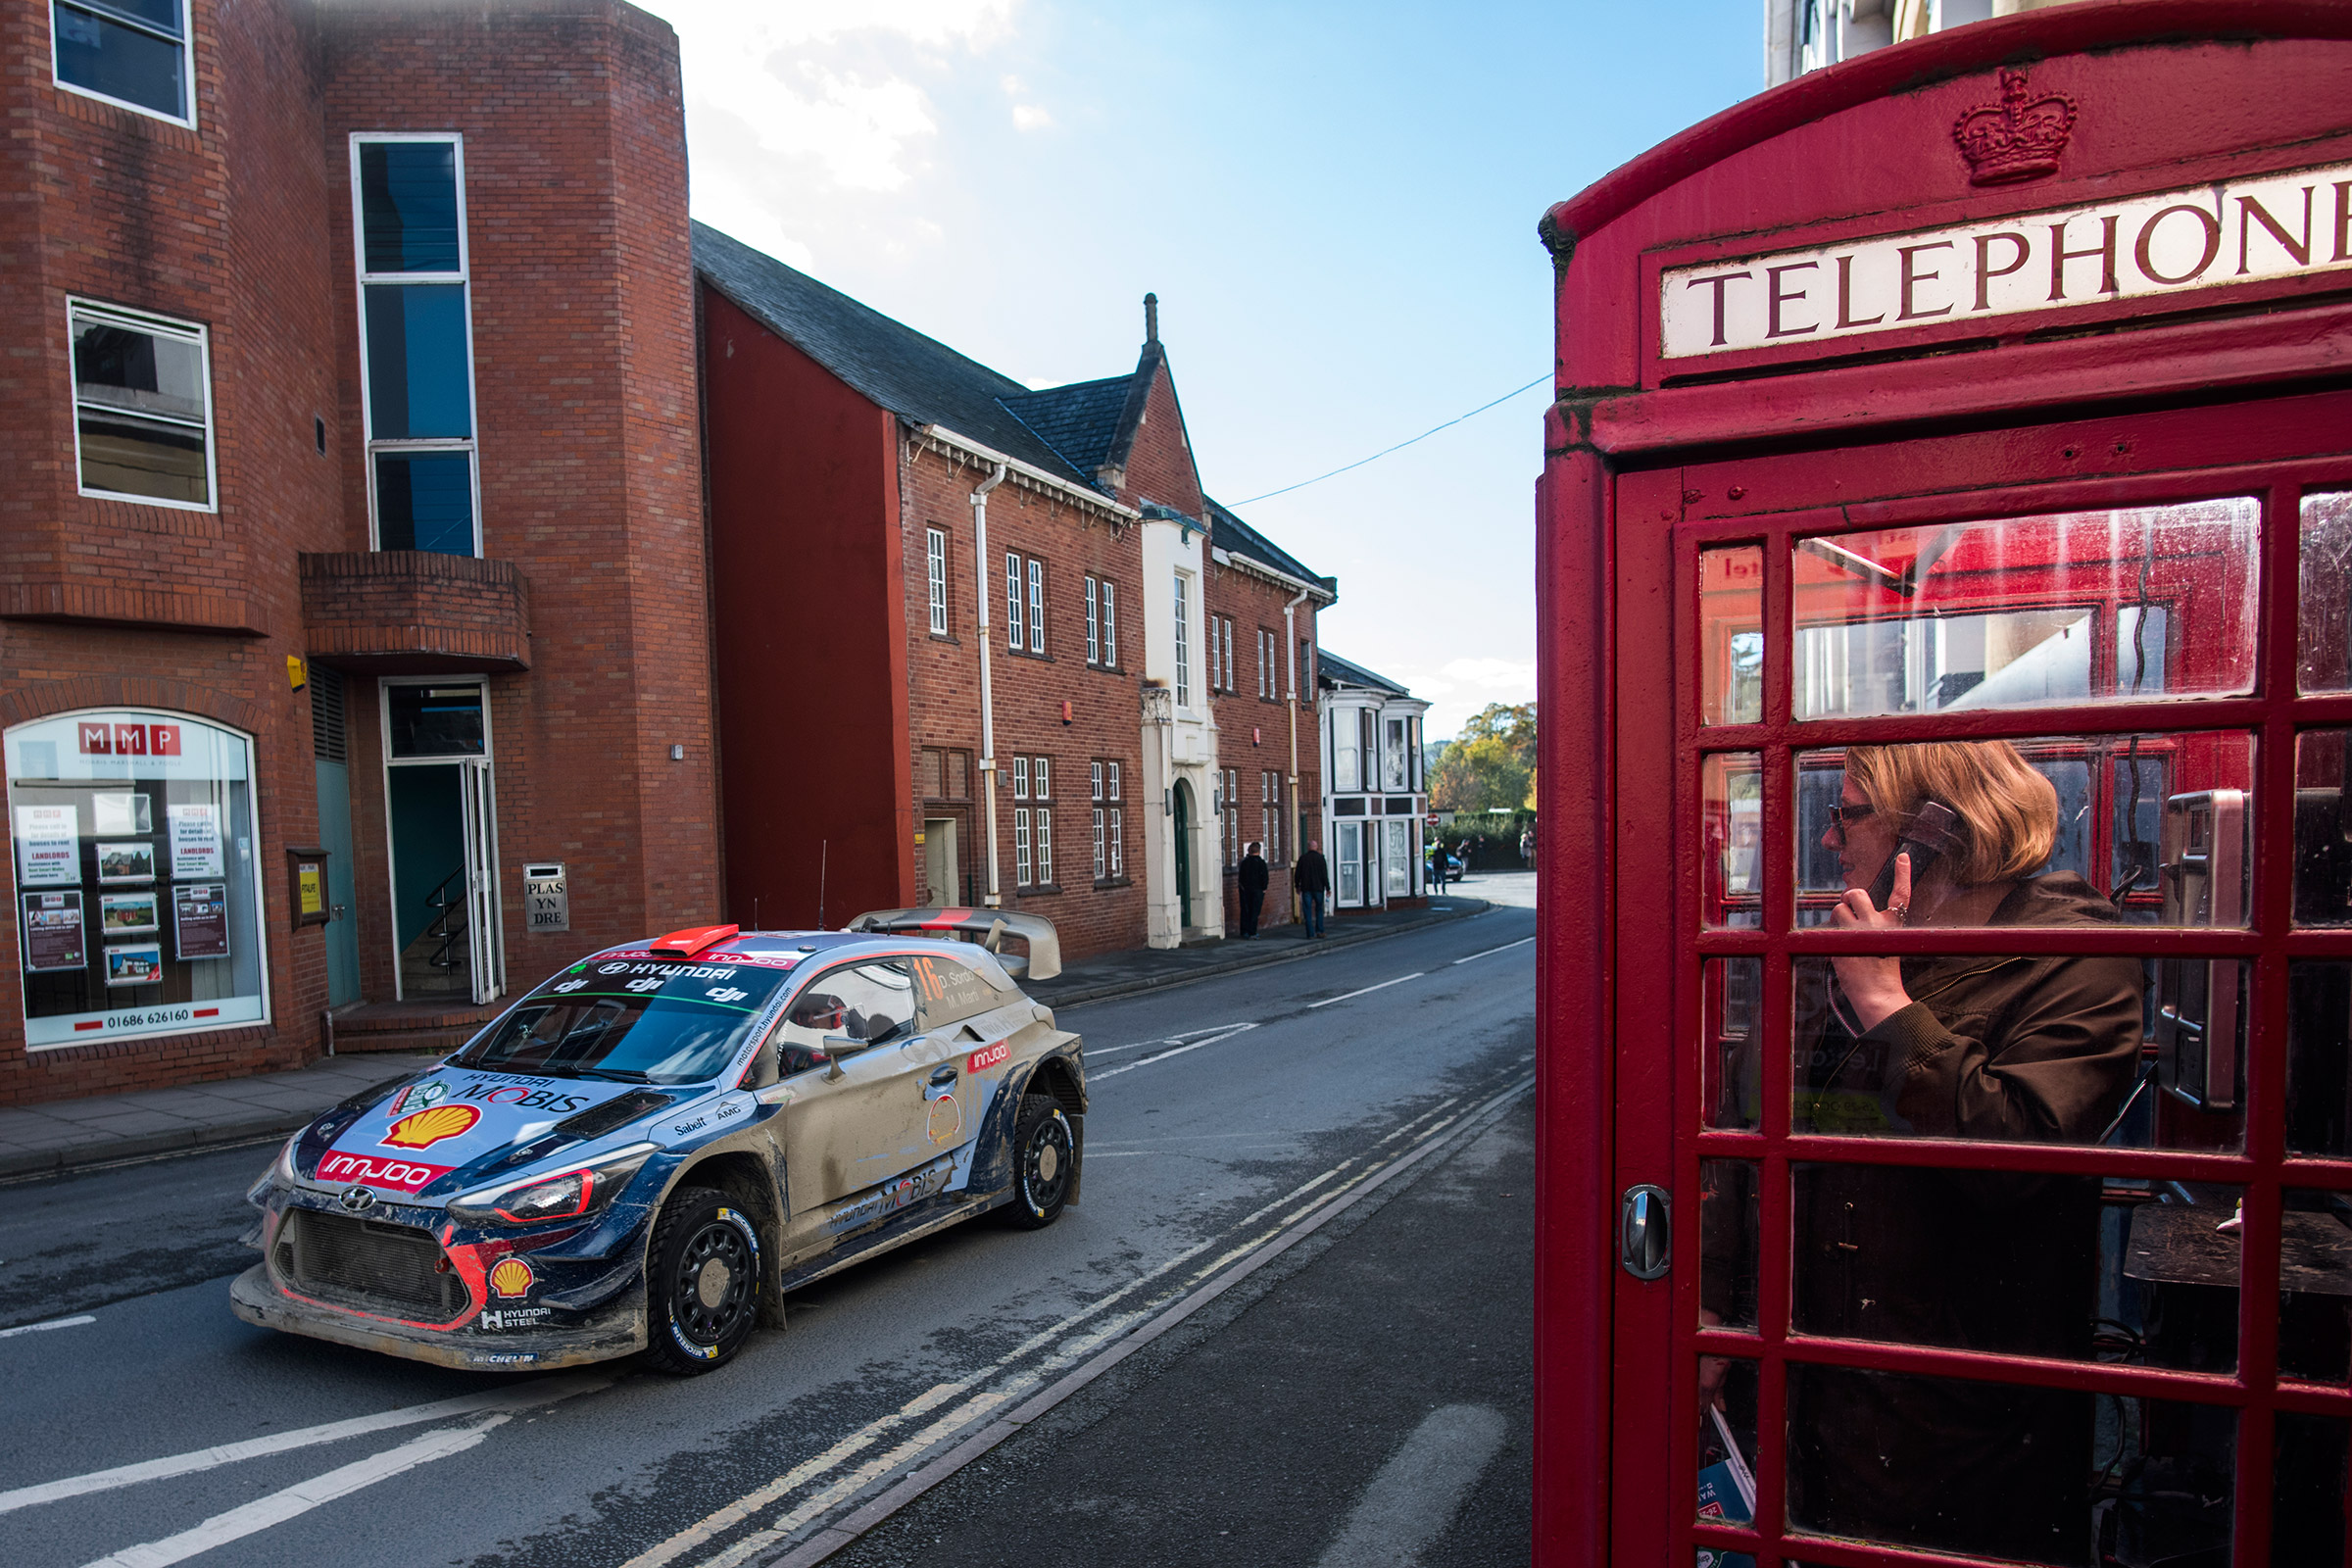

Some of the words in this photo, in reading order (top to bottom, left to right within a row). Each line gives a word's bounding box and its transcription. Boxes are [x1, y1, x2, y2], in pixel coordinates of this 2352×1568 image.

[528, 883, 564, 894] PLAS
[536, 898, 557, 908] YN
[534, 911, 562, 924] DRE
[628, 963, 737, 980] HYUNDAI
[913, 956, 944, 1002] 16
[949, 971, 975, 986] Sordo
[108, 1014, 143, 1028] 01686
[147, 1009, 189, 1024] 626160
[737, 987, 793, 1067] motorsport.hyundai.com
[464, 1073, 556, 1088] HYUNDAI
[450, 1084, 591, 1113] MOBIS
[674, 1116, 708, 1136] Sabelt
[504, 1307, 551, 1318] HYUNDAI
[505, 1317, 540, 1327] STEEL
[672, 1326, 704, 1357] MICHELIN
[473, 1354, 534, 1363] MICHELIN
